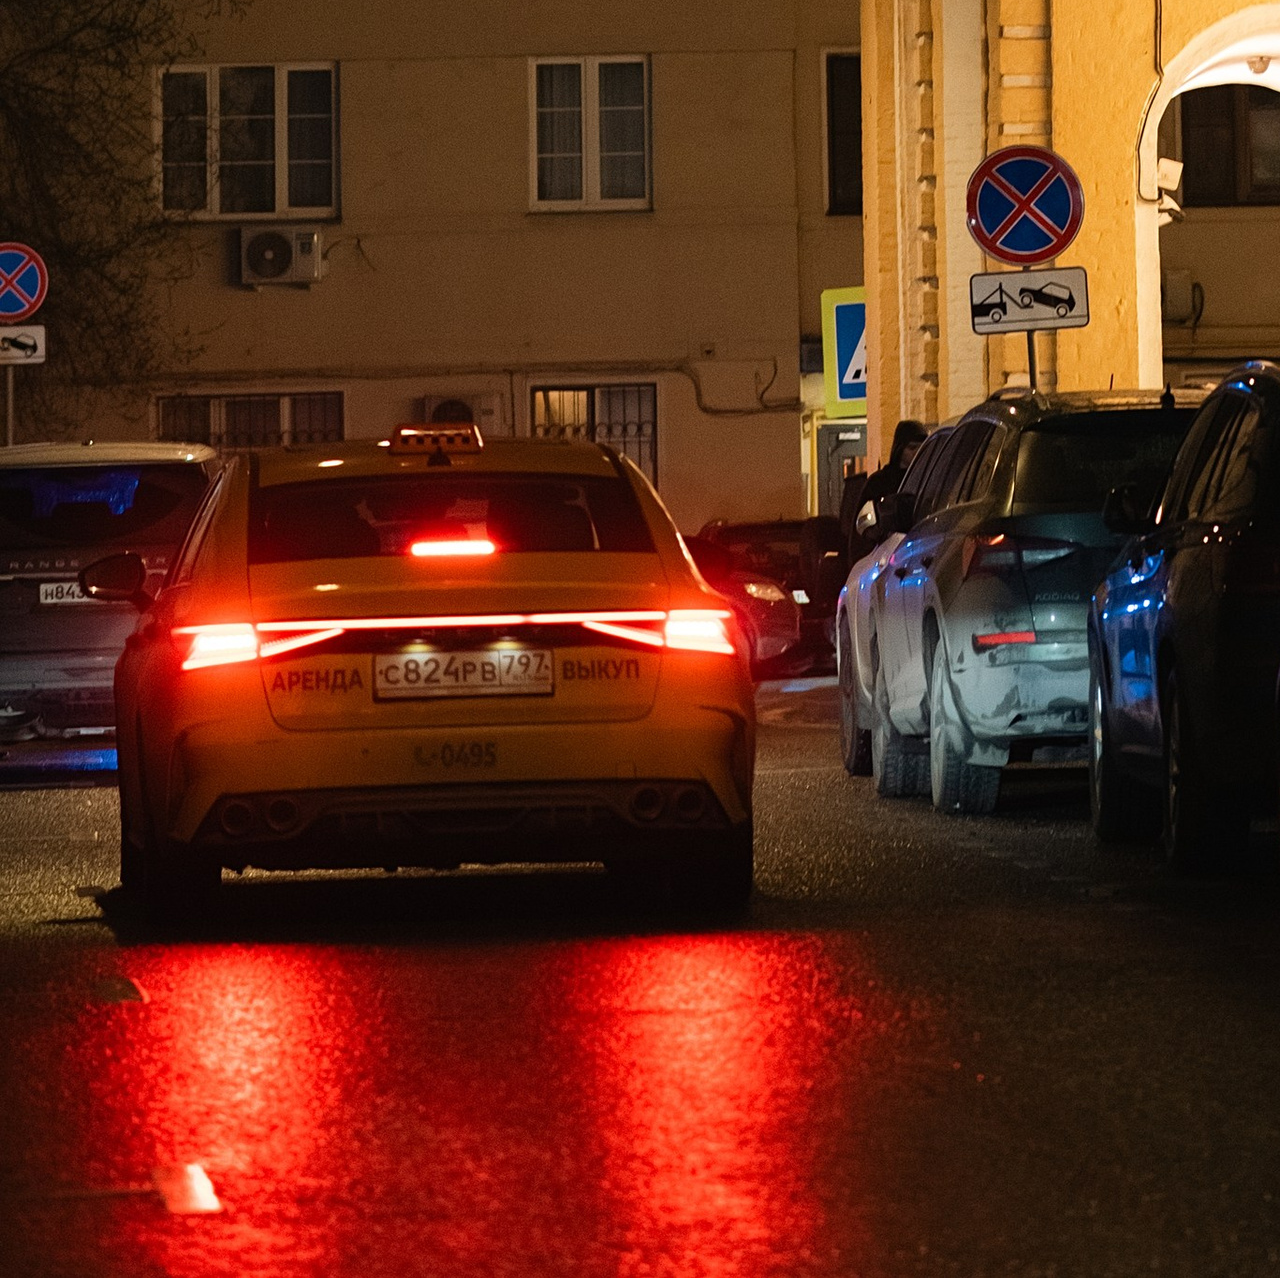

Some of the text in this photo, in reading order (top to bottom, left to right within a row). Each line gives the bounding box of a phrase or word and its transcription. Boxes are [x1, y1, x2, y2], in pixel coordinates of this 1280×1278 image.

[271, 668, 365, 694] АРЕНДА
[383, 653, 546, 685] С824РВ 797
[562, 658, 640, 681] ВЫКУП
